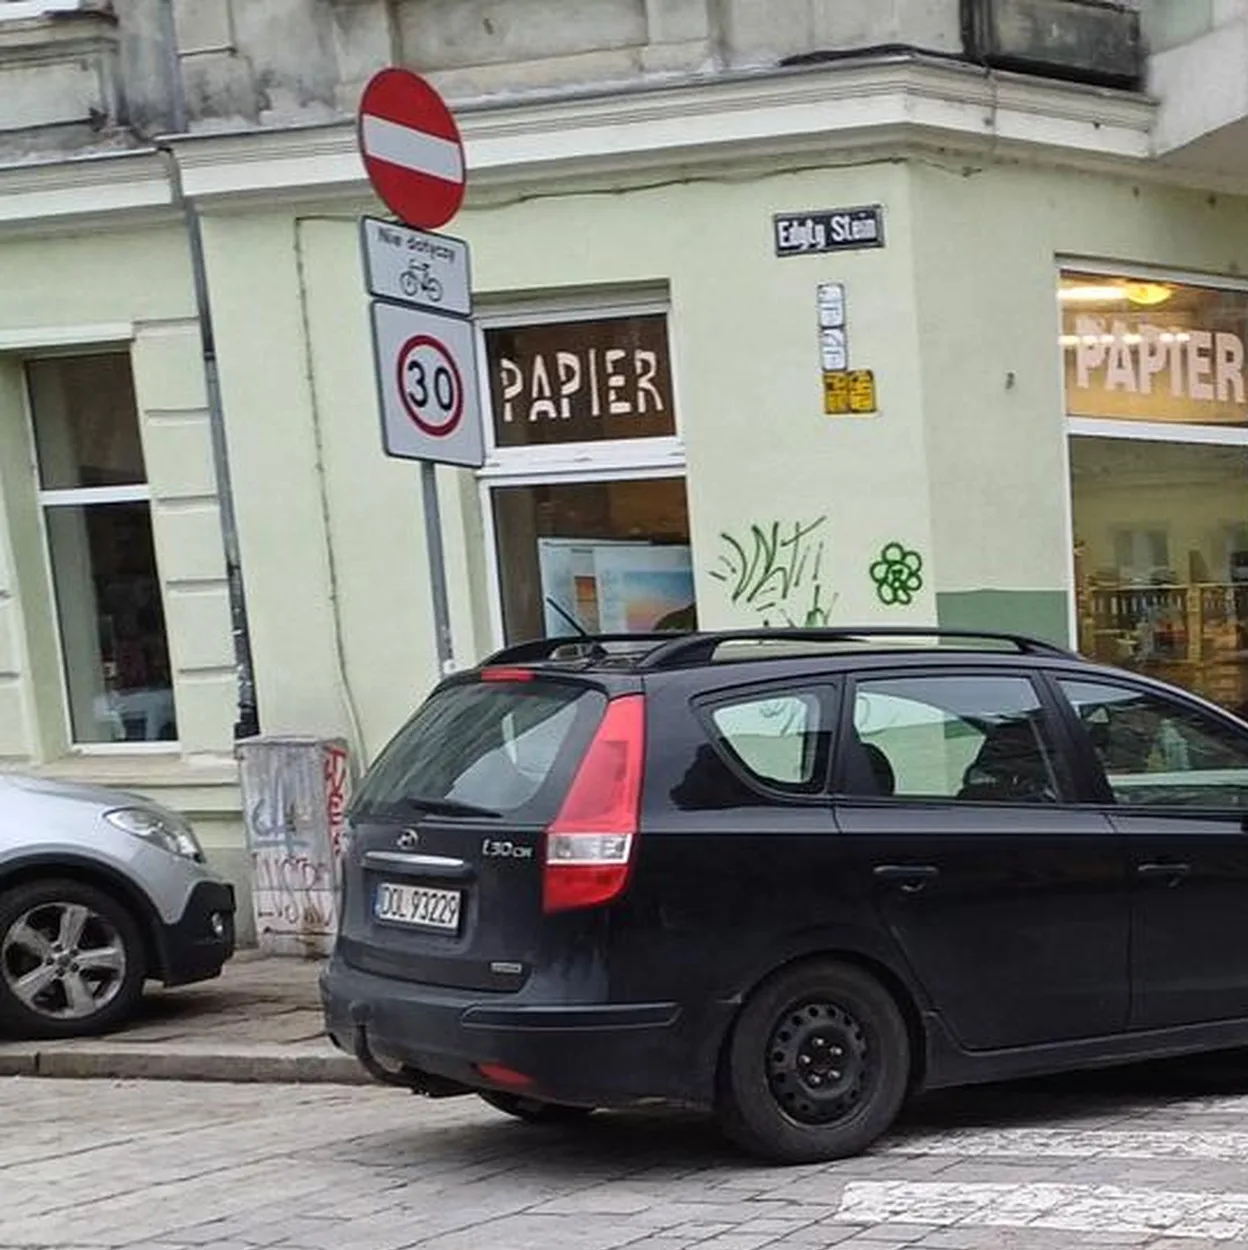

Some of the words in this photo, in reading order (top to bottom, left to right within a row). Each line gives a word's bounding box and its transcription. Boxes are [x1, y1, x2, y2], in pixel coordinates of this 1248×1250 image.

[407, 359, 454, 412] 30
[500, 348, 664, 423] PAPIER
[1074, 314, 1247, 404] PAPIER
